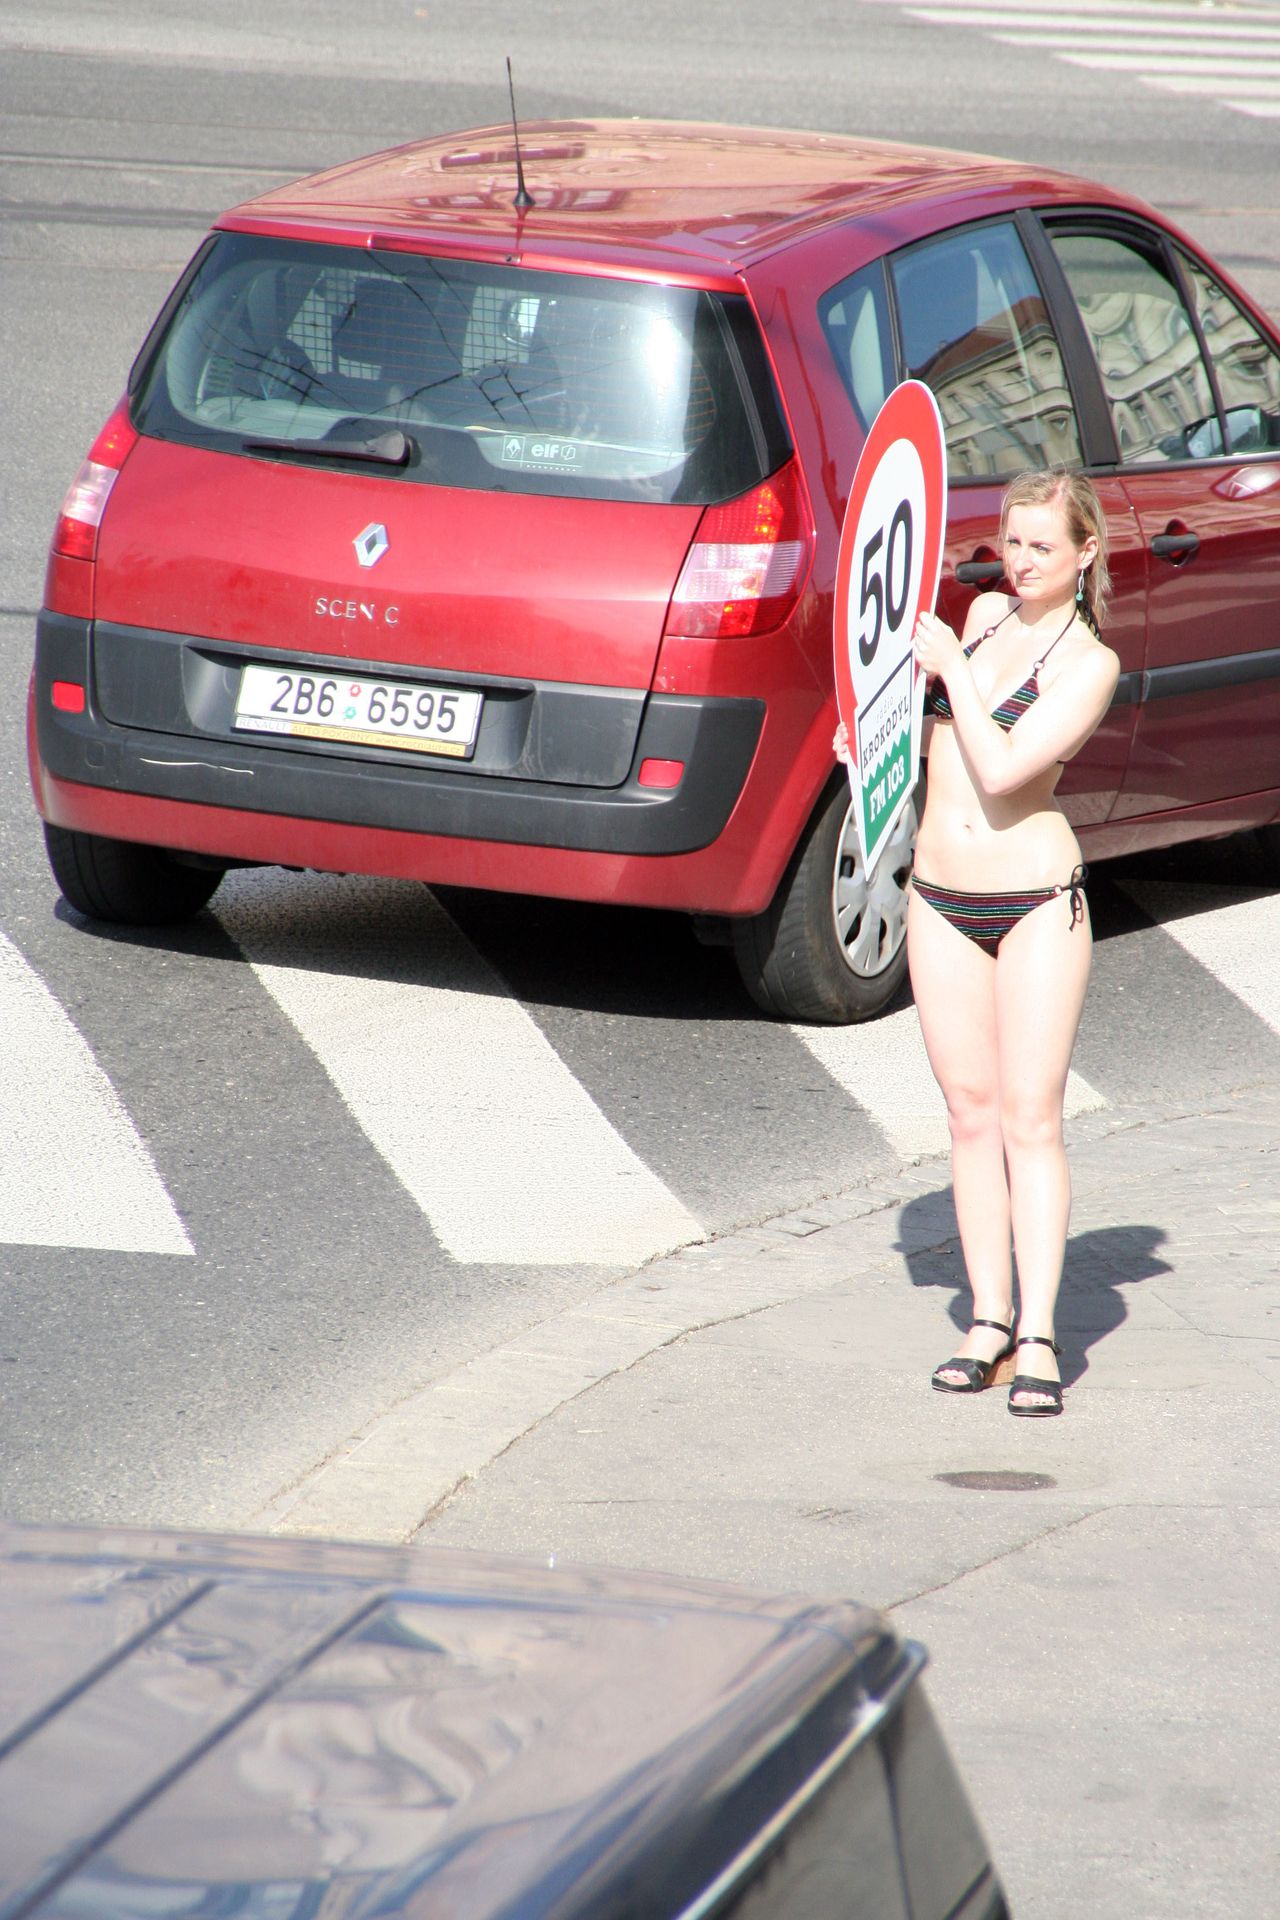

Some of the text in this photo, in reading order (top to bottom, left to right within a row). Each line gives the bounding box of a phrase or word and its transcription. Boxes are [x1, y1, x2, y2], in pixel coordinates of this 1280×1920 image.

[531, 443, 560, 459] elf
[858, 498, 913, 667] 50
[315, 597, 399, 624] SCENC
[270, 675, 460, 733] 2B6 6595
[238, 717, 287, 732] RENAULT
[869, 779, 887, 823] FM
